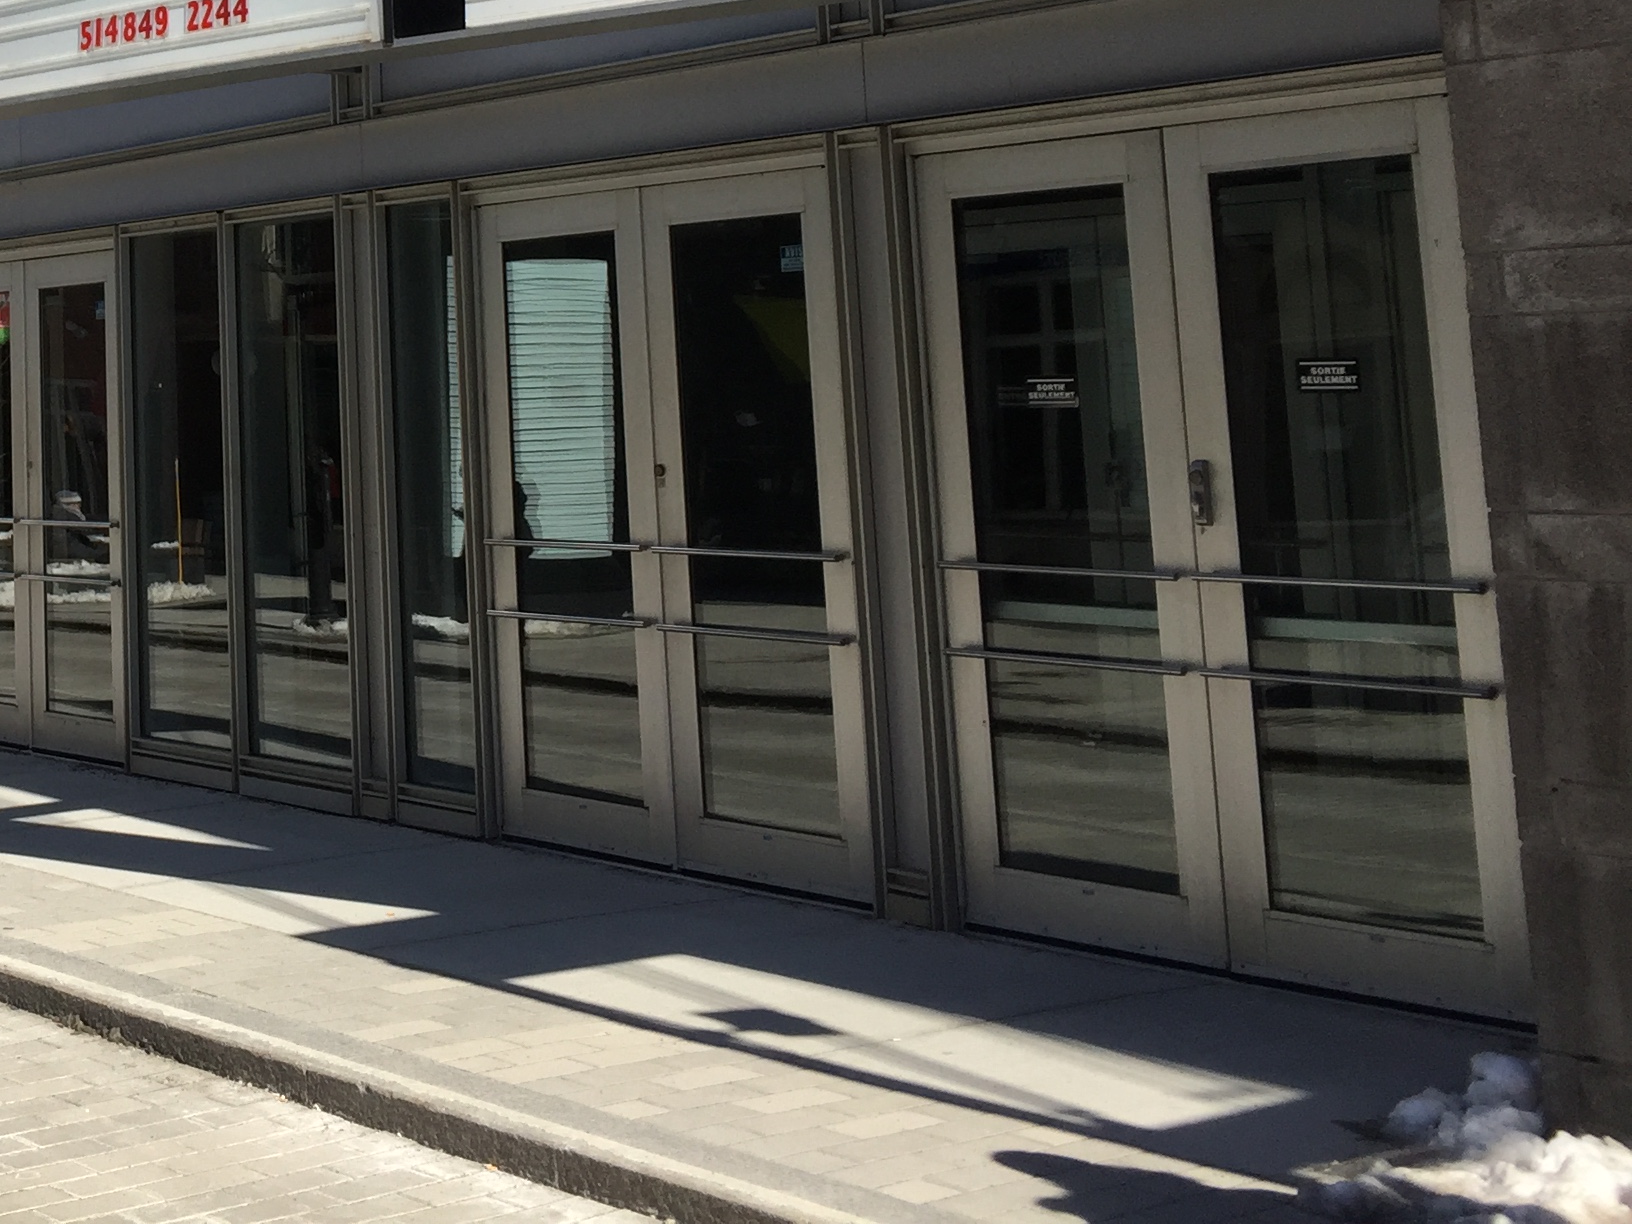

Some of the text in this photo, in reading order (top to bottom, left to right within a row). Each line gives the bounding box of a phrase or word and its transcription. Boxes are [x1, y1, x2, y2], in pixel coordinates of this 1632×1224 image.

[79, 6, 168, 51] 514849
[1310, 367, 1346, 375] SORTIE
[1300, 375, 1358, 384] SEULEMENT
